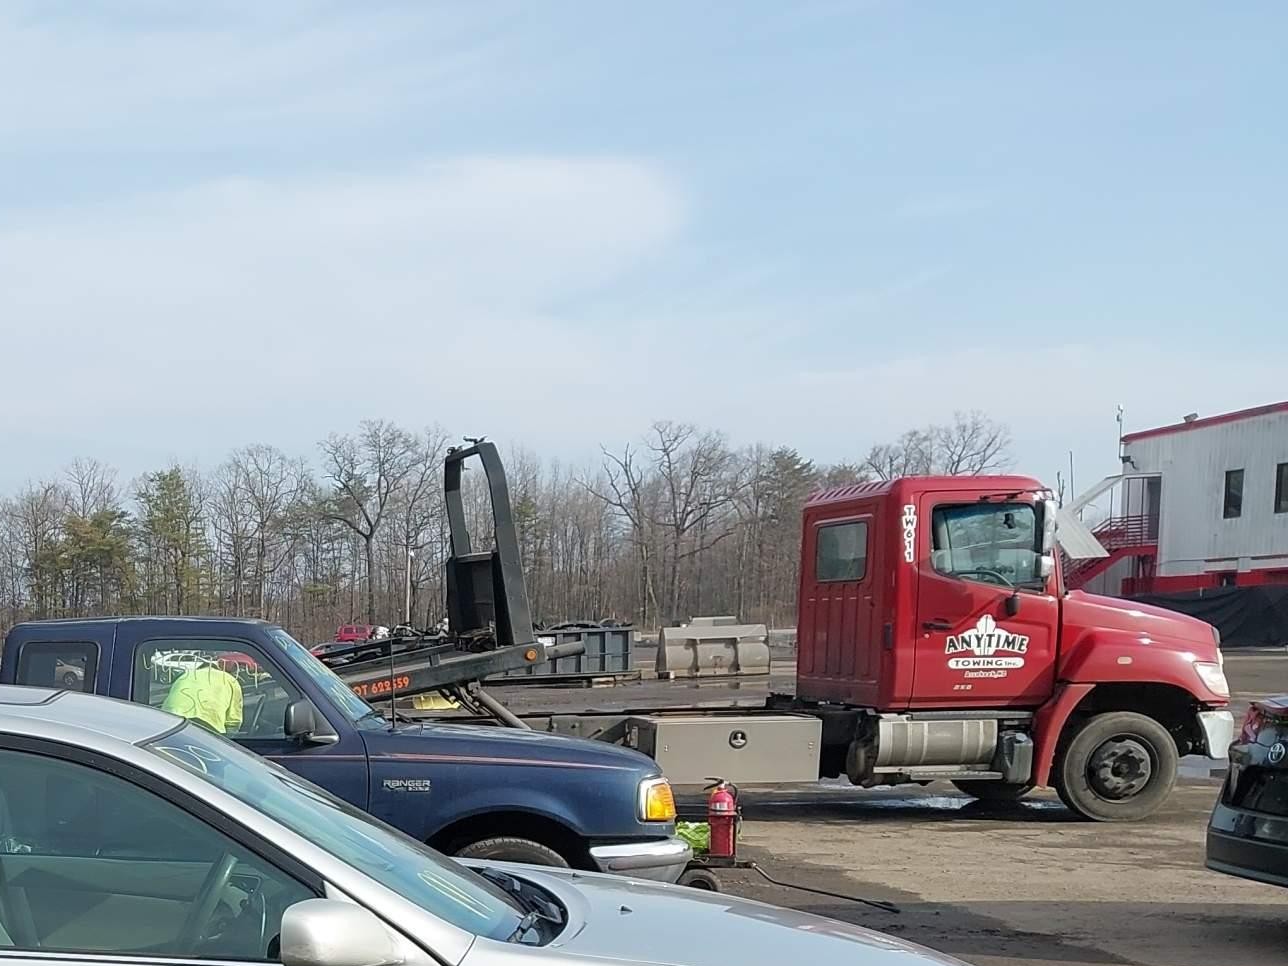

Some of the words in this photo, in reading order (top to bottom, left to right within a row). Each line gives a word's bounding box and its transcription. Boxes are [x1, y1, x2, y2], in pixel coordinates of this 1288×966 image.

[904, 506, 915, 561] TW611
[947, 633, 1026, 653] ANYTIME
[954, 659, 1003, 668] TOWING
[383, 779, 431, 790] RANGER
